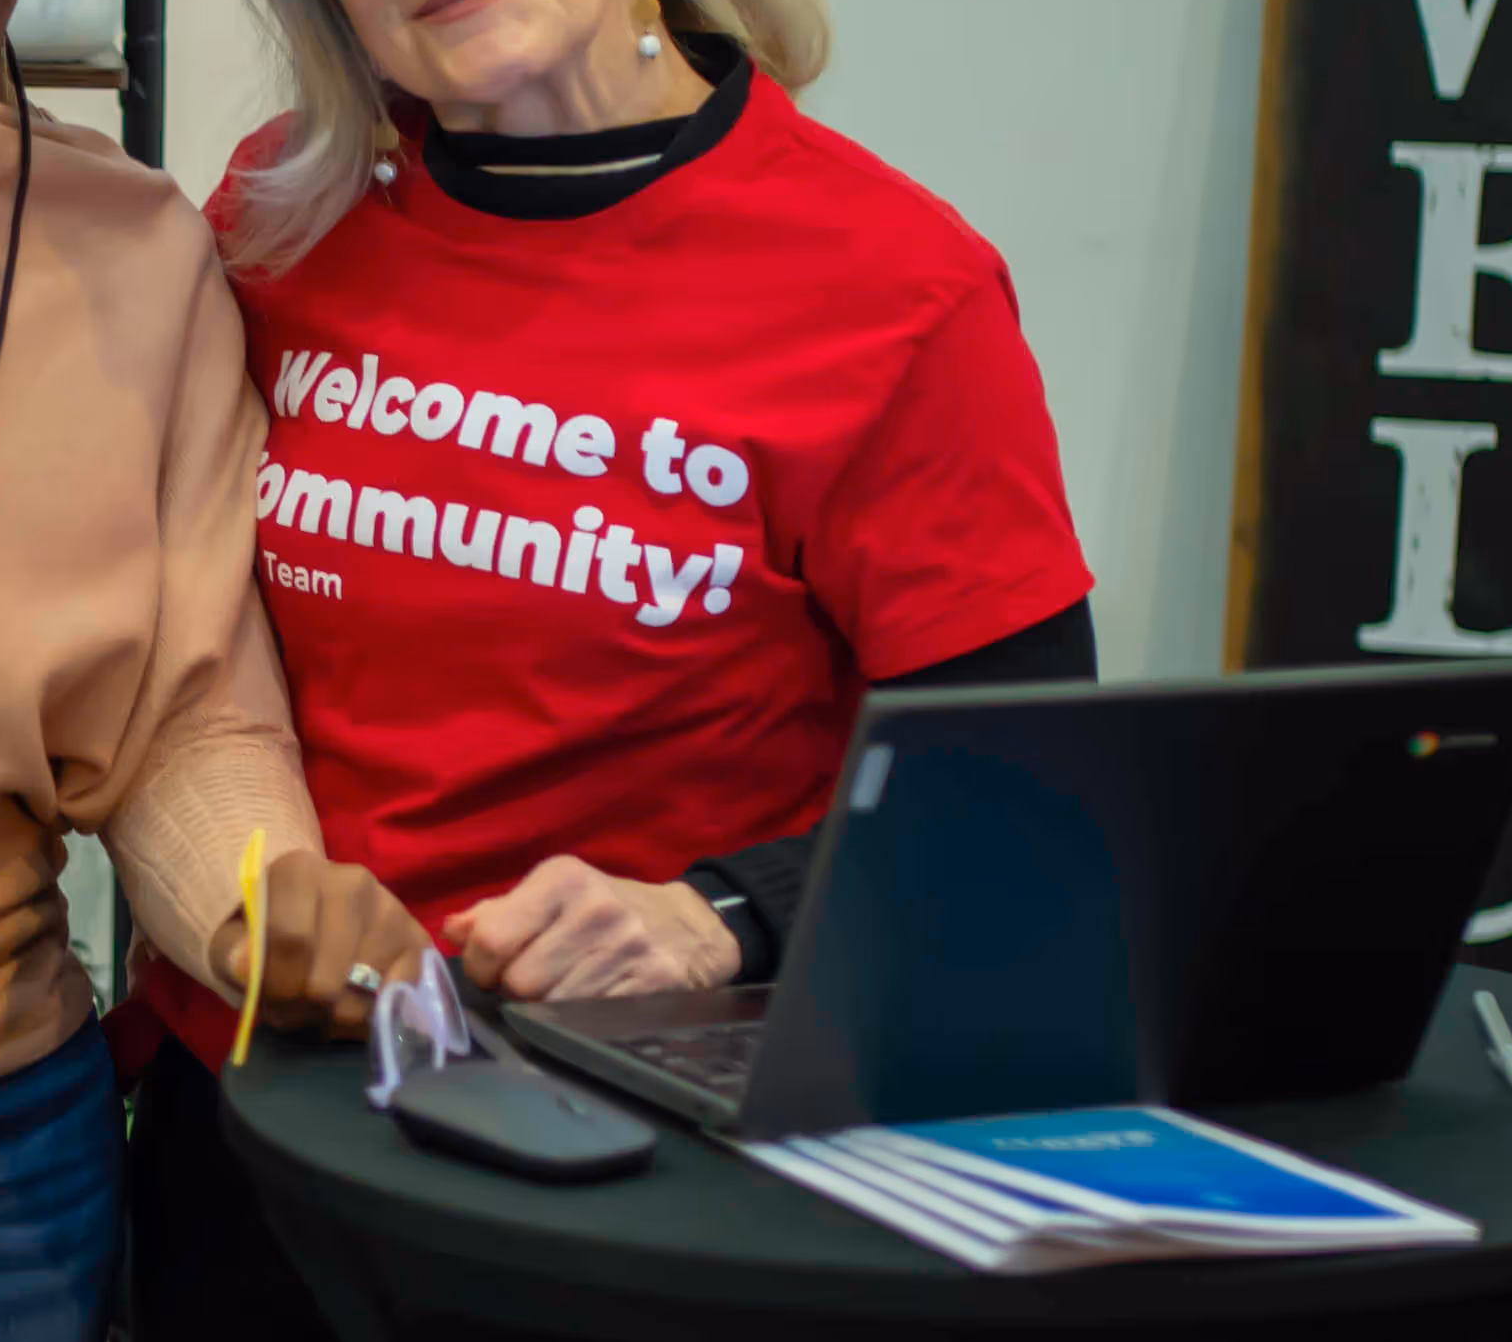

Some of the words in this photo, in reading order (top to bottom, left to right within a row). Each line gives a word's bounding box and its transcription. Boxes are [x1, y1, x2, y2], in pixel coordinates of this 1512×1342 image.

[274, 349, 615, 477] Welcome
[641, 417, 749, 507] to
[255, 451, 743, 627] ommunity!
[264, 549, 342, 600] Team
